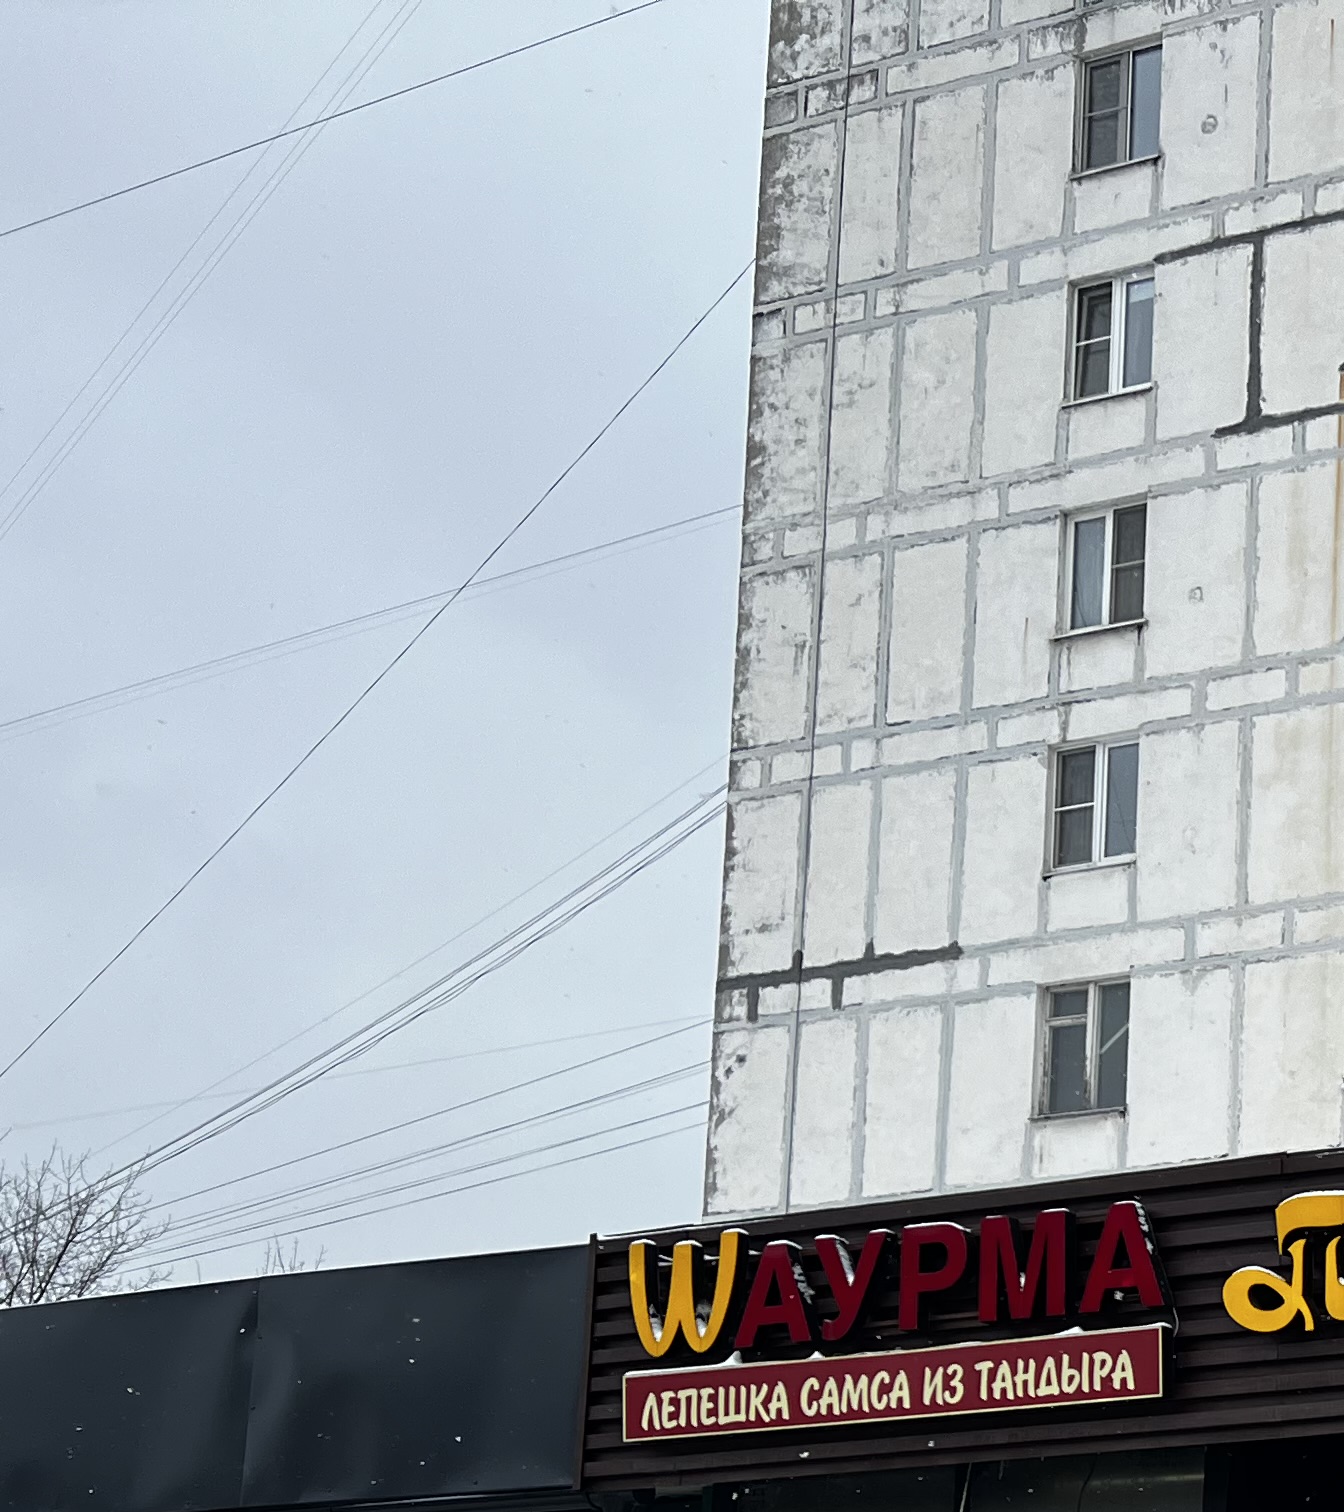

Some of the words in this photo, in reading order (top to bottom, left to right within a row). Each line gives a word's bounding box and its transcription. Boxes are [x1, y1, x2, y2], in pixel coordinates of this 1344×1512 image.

[640, 1380, 790, 1431] ЛЕПЕШКА
[800, 1370, 909, 1418] САМСА
[922, 1362, 965, 1404] ИЗ
[974, 1349, 1136, 1400] ТАНДЫРА
